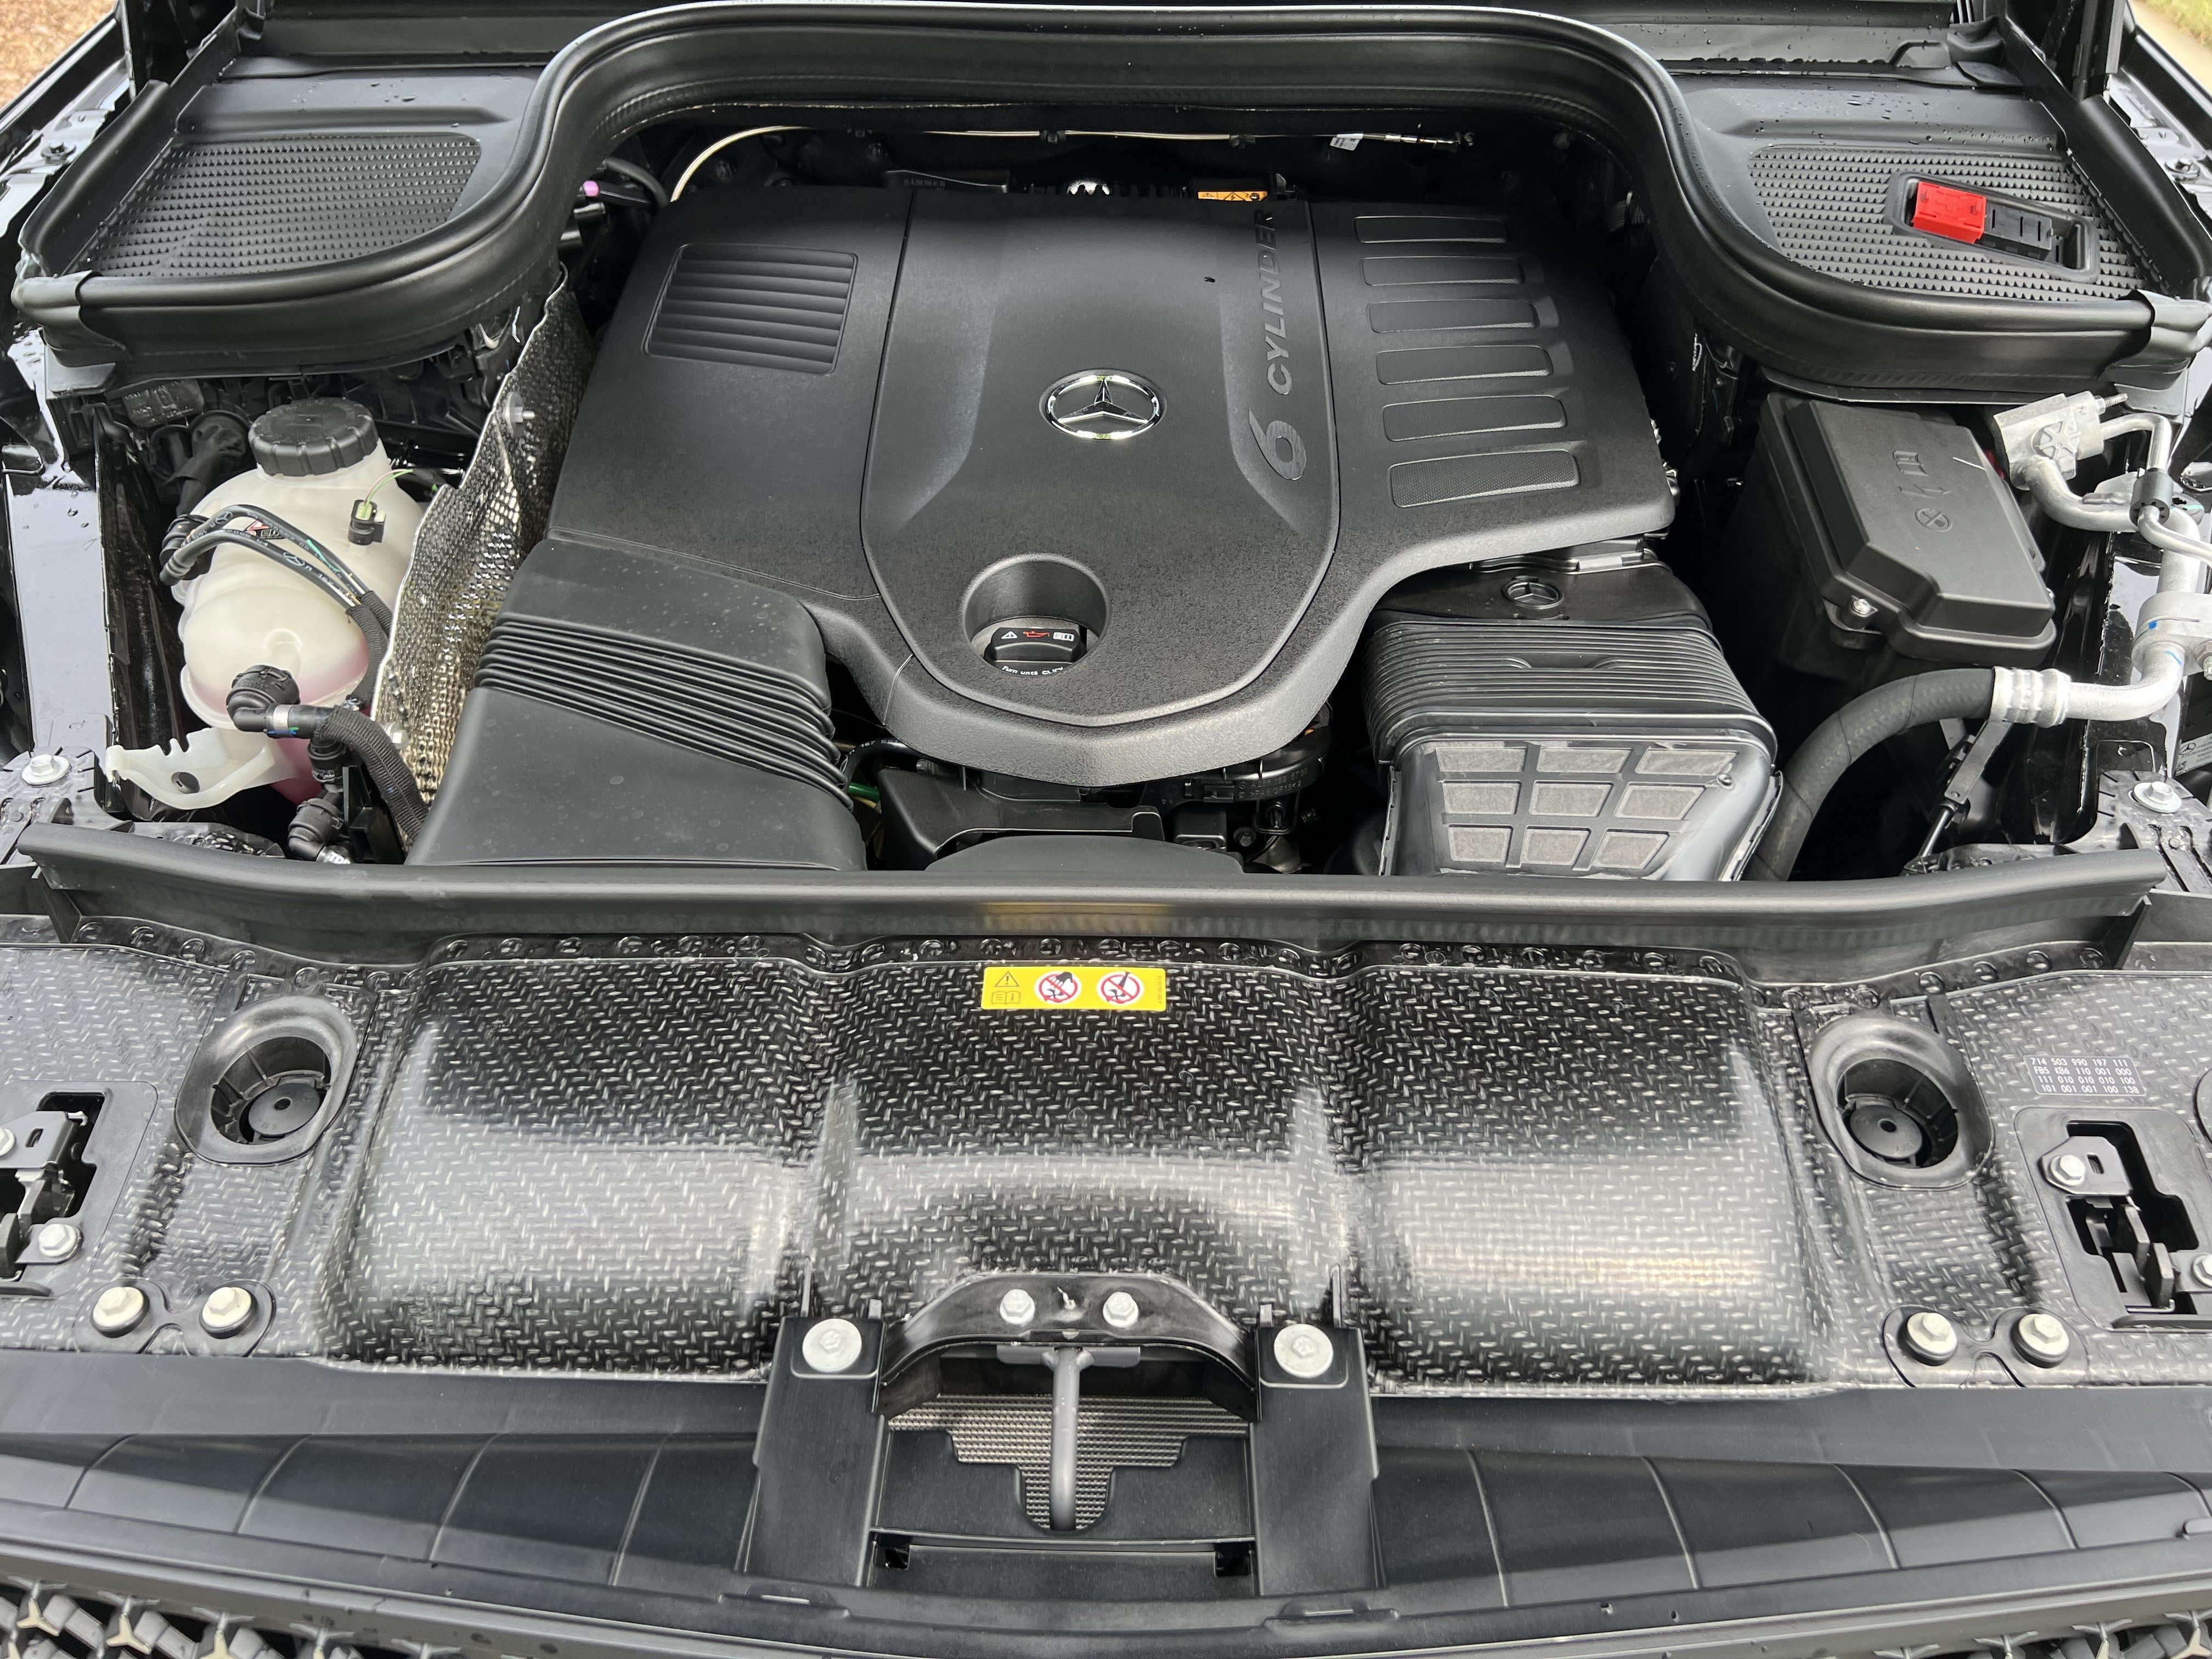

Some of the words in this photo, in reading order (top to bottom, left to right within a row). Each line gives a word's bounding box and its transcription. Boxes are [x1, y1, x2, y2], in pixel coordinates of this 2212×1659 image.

[1254, 209, 1293, 396] CYLINDER
[1249, 408, 1307, 481] 6
[1001, 665, 1018, 674] Turn
[2030, 1057, 2047, 1065] 714
[2051, 1058, 2068, 1066] 503
[2054, 1066, 2070, 1075] KB6
[2075, 1067, 2091, 1075] 110
[2115, 1068, 2132, 1076] 000
[2038, 1075, 2053, 1084] 111
[2078, 1076, 2095, 1084] 010
[2041, 1084, 2056, 1093] 101
[2061, 1085, 2077, 1093] 001
[2081, 1085, 2097, 1093] 001
[2102, 1085, 2119, 1093] 100
[2123, 1086, 2140, 1094] 138
